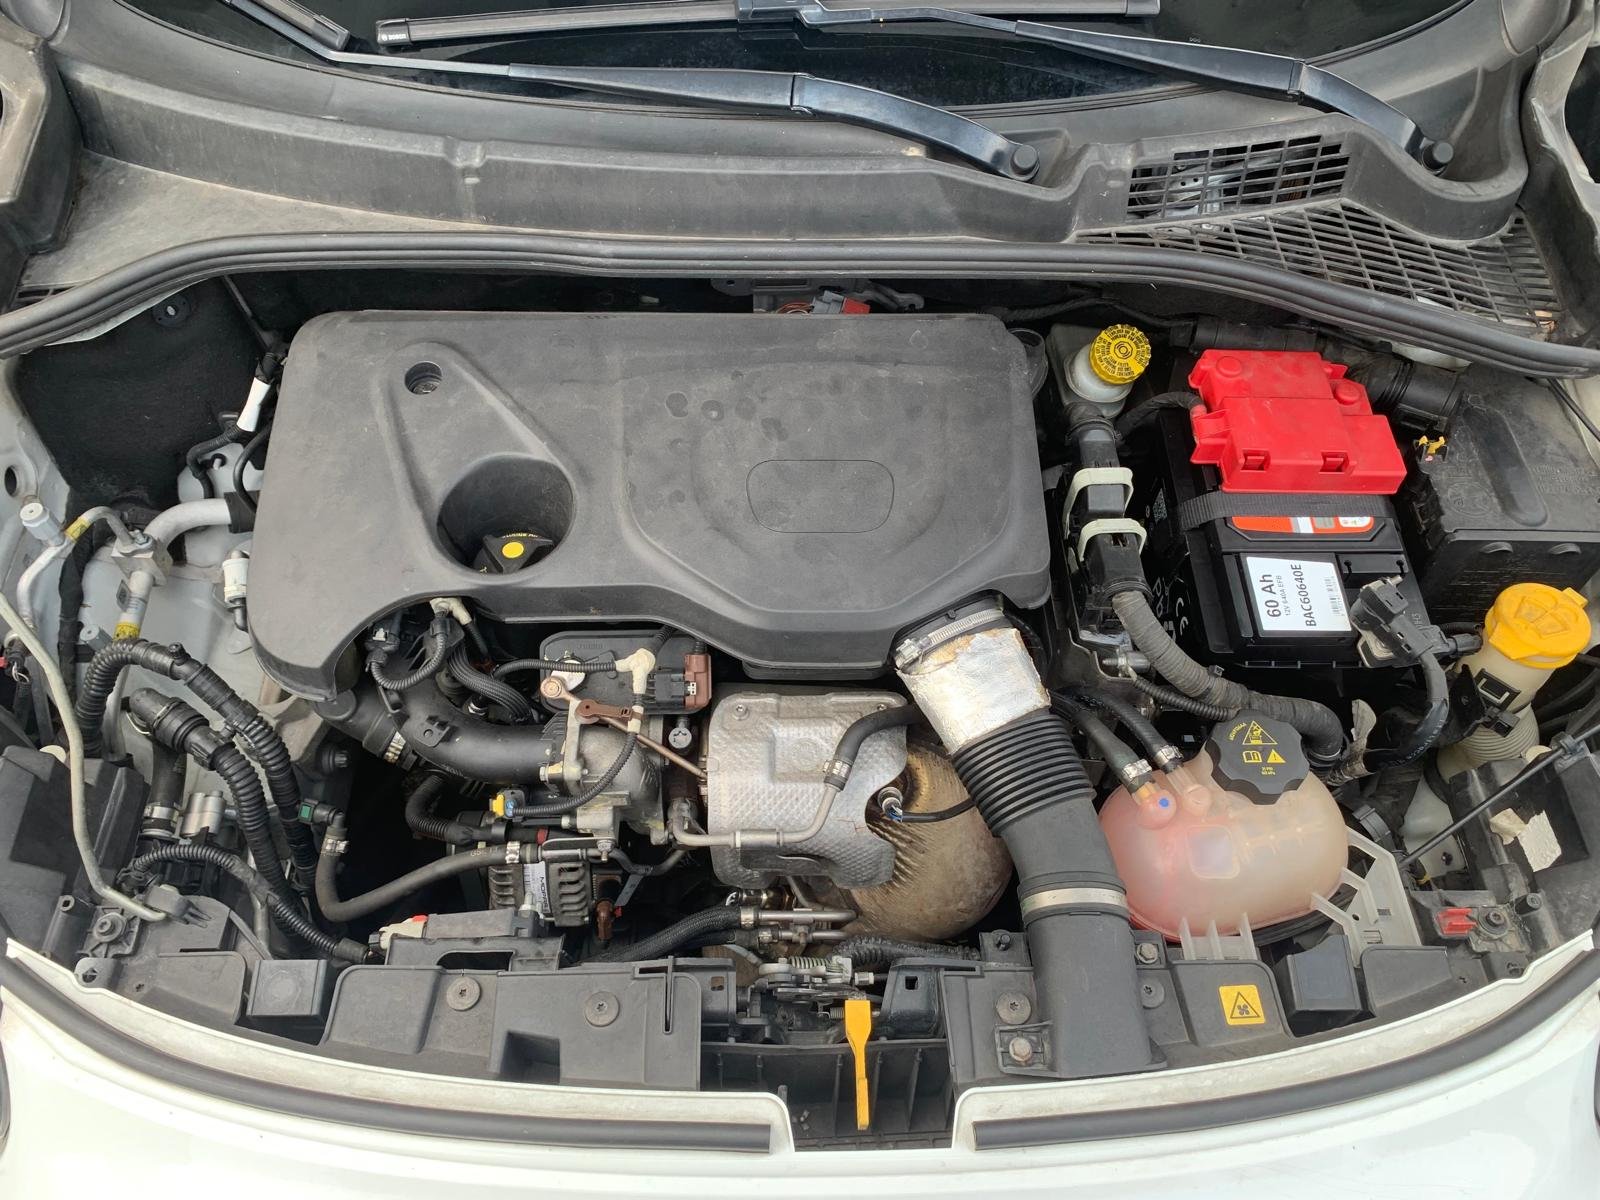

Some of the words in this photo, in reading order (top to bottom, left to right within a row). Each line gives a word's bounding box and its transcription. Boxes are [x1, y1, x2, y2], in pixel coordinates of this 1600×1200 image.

[1259, 574, 1277, 595] Ah
[1275, 575, 1284, 588] EFB
[1279, 588, 1288, 604] 640A
[1290, 563, 1317, 627] BAC60640E
[1264, 599, 1282, 618] 60
[1283, 605, 1291, 616] 12V
